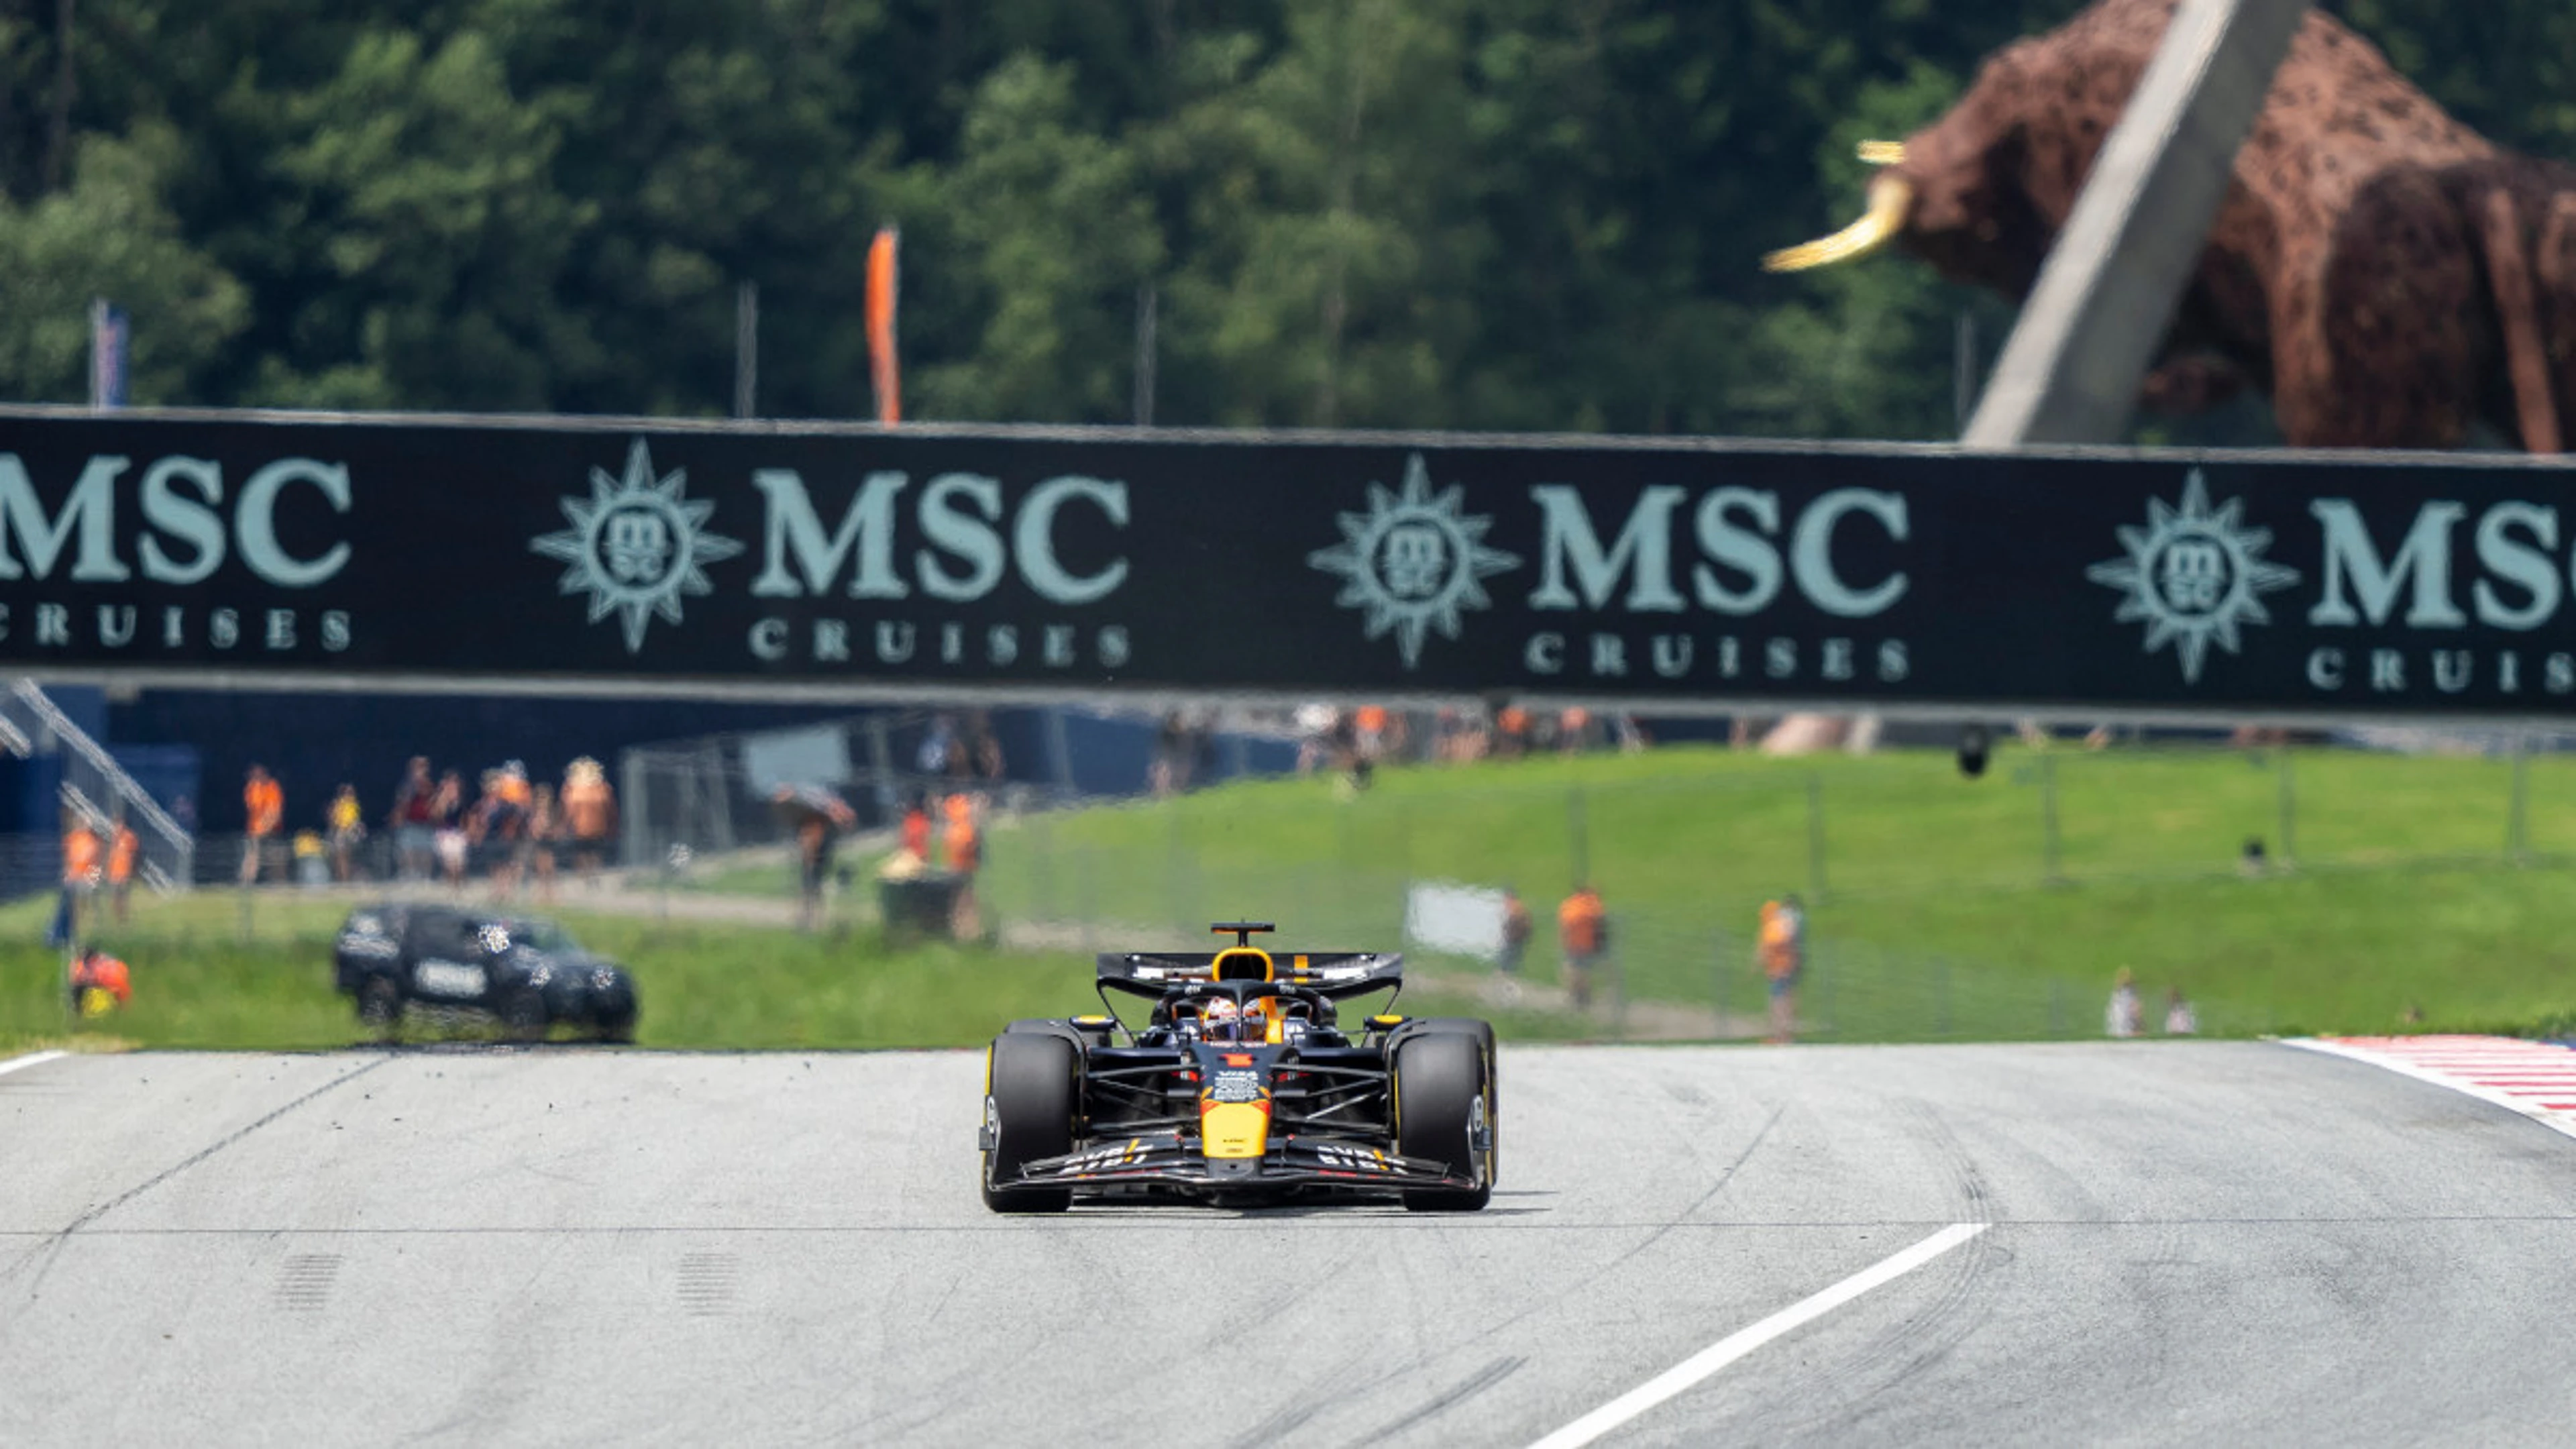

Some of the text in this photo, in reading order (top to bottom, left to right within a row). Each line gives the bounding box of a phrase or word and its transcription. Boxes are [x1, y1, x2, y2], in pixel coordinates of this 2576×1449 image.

[0, 453, 352, 588] MSC
[751, 468, 1131, 604] MSC
[1527, 484, 1910, 617] MSC
[2308, 498, 2576, 630] MS
[749, 618, 1130, 667] CRUISES
[1525, 632, 1909, 680] CRUISES
